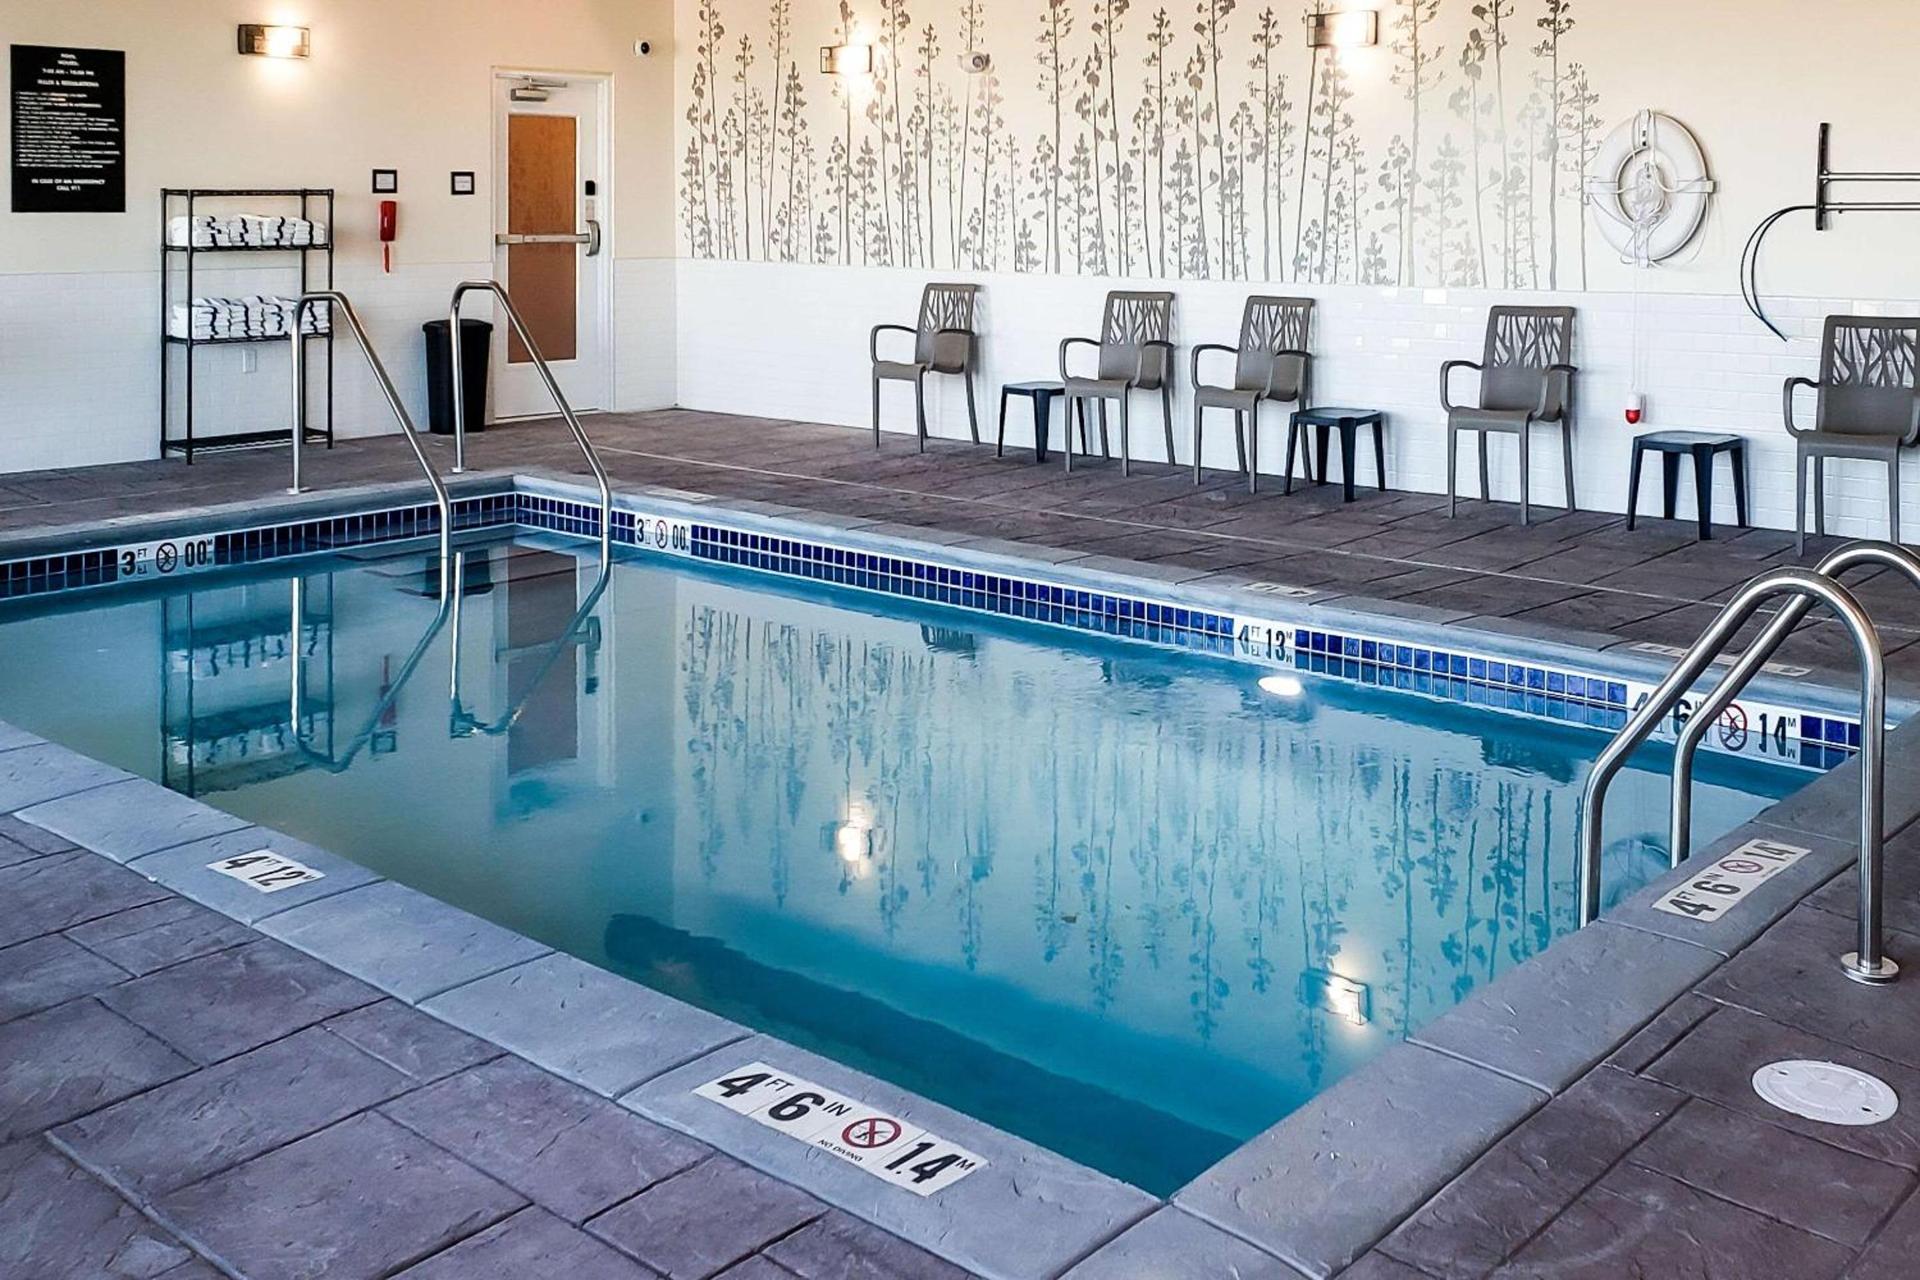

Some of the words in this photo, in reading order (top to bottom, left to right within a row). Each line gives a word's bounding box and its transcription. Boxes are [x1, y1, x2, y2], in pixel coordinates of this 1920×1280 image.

[224, 856, 270, 870] 4
[1669, 899, 1717, 916] 4
[1693, 881, 1741, 895] 6
[717, 1073, 772, 1097] 4
[764, 1079, 794, 1091] FT
[768, 1092, 825, 1121] 6
[823, 1101, 852, 1117] IN
[885, 1142, 961, 1183] 1.4
[955, 1159, 975, 1170] M
